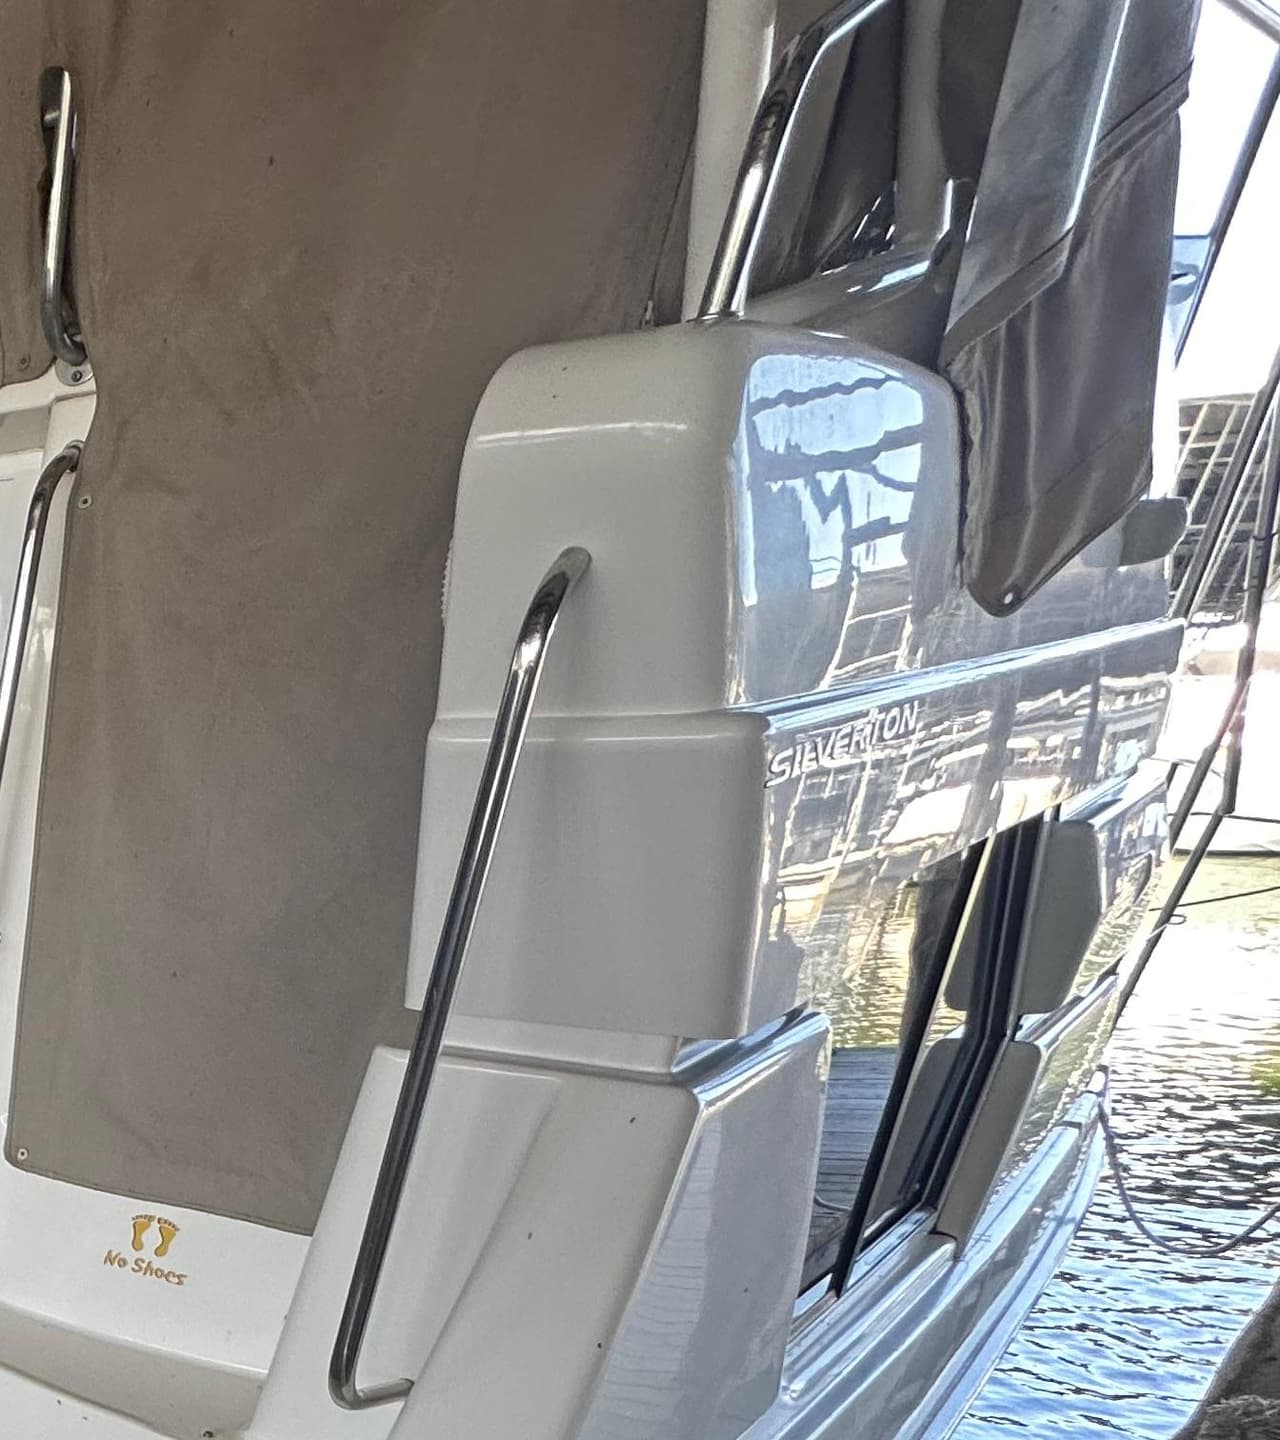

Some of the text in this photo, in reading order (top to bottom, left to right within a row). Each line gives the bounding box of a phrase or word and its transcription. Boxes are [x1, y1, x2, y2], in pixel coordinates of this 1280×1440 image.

[765, 701, 919, 788] SILVERTON
[103, 1249, 188, 1286] No Shoes
